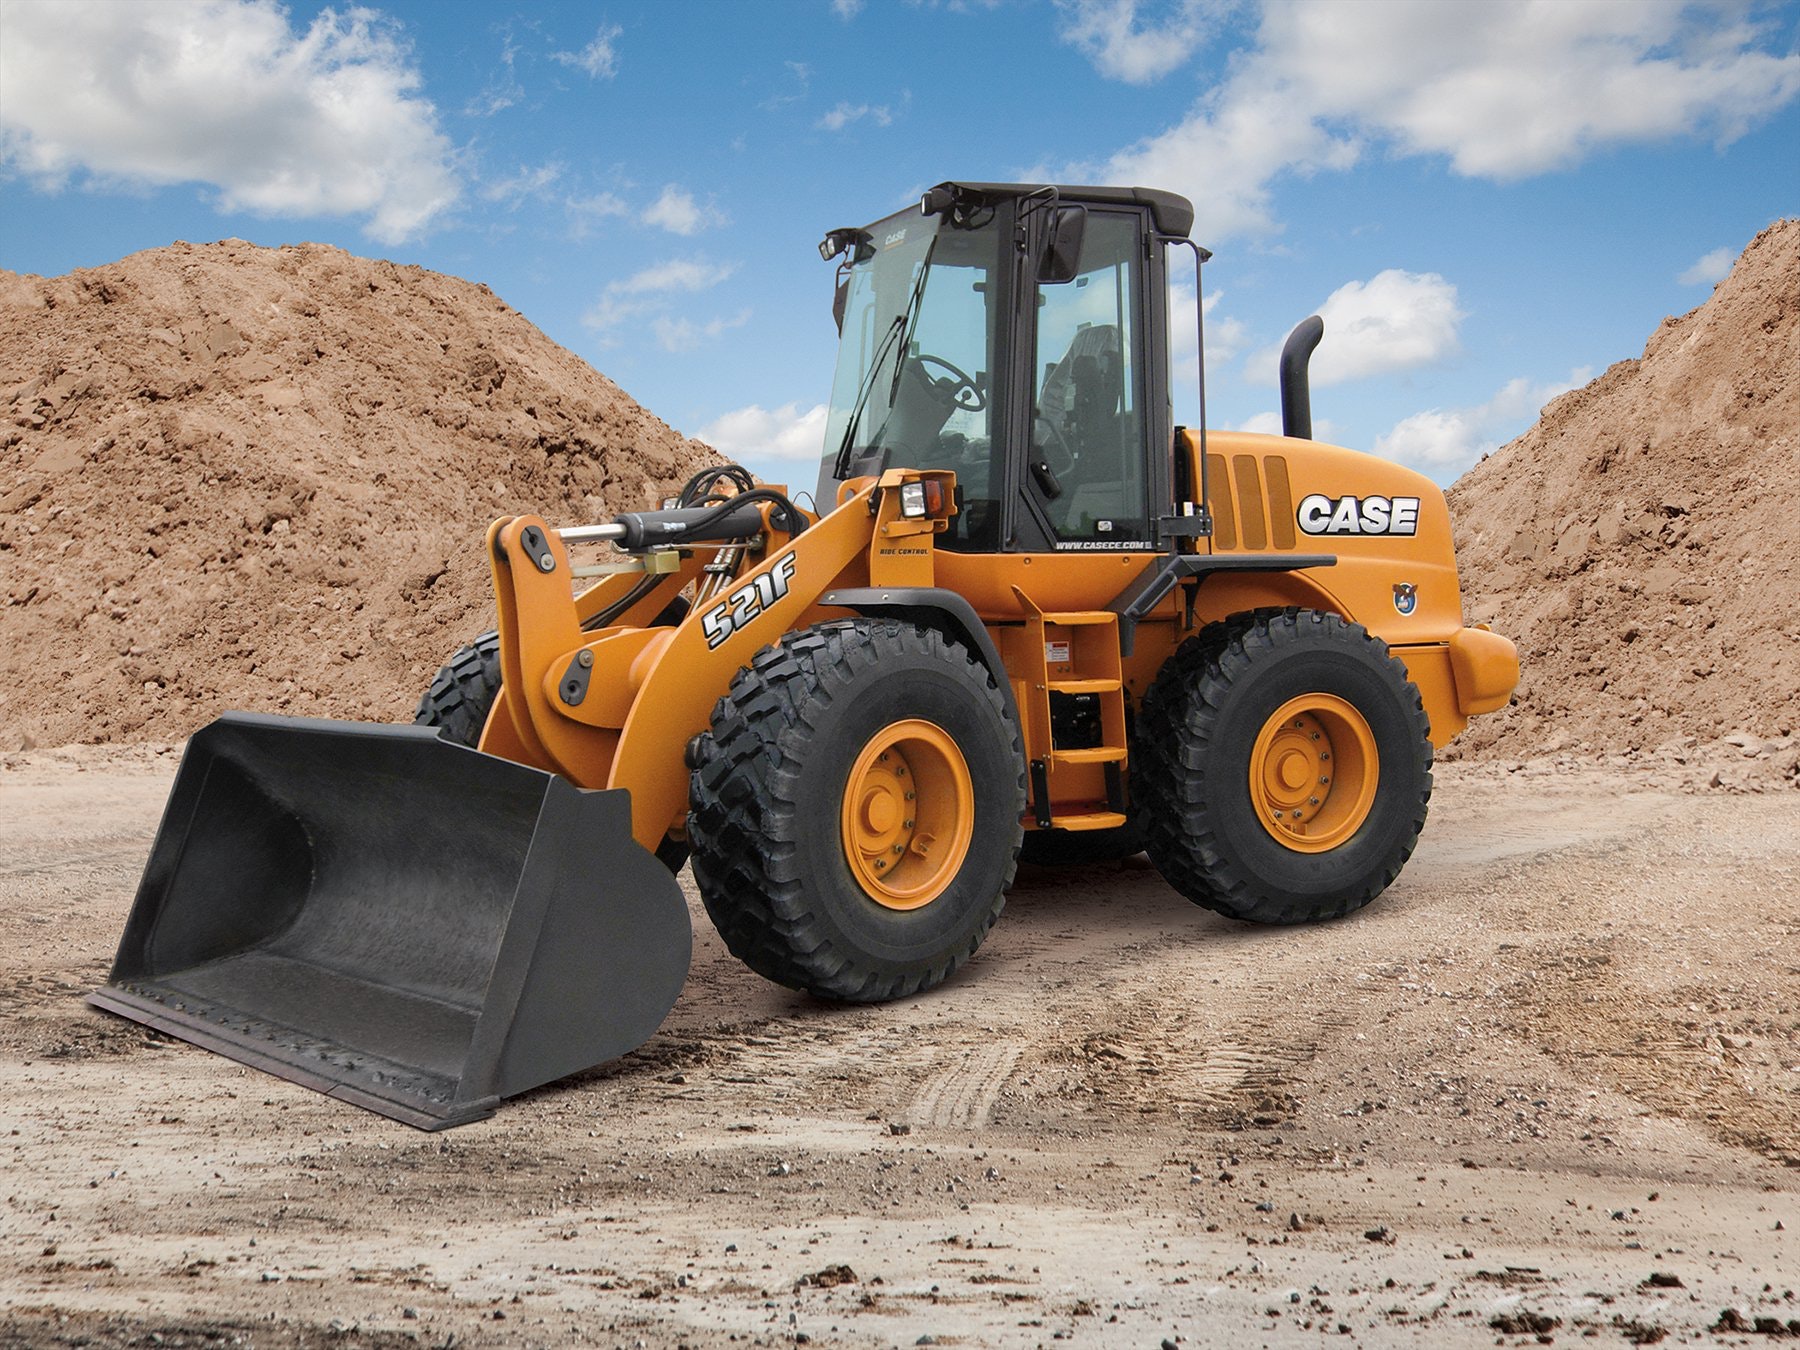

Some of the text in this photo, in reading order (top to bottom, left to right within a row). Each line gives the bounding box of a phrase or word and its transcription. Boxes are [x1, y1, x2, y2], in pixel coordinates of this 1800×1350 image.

[1297, 494, 1420, 536] CASE
[1056, 541, 1145, 550] WWW.CASECE.COM
[701, 550, 796, 650] 521F
